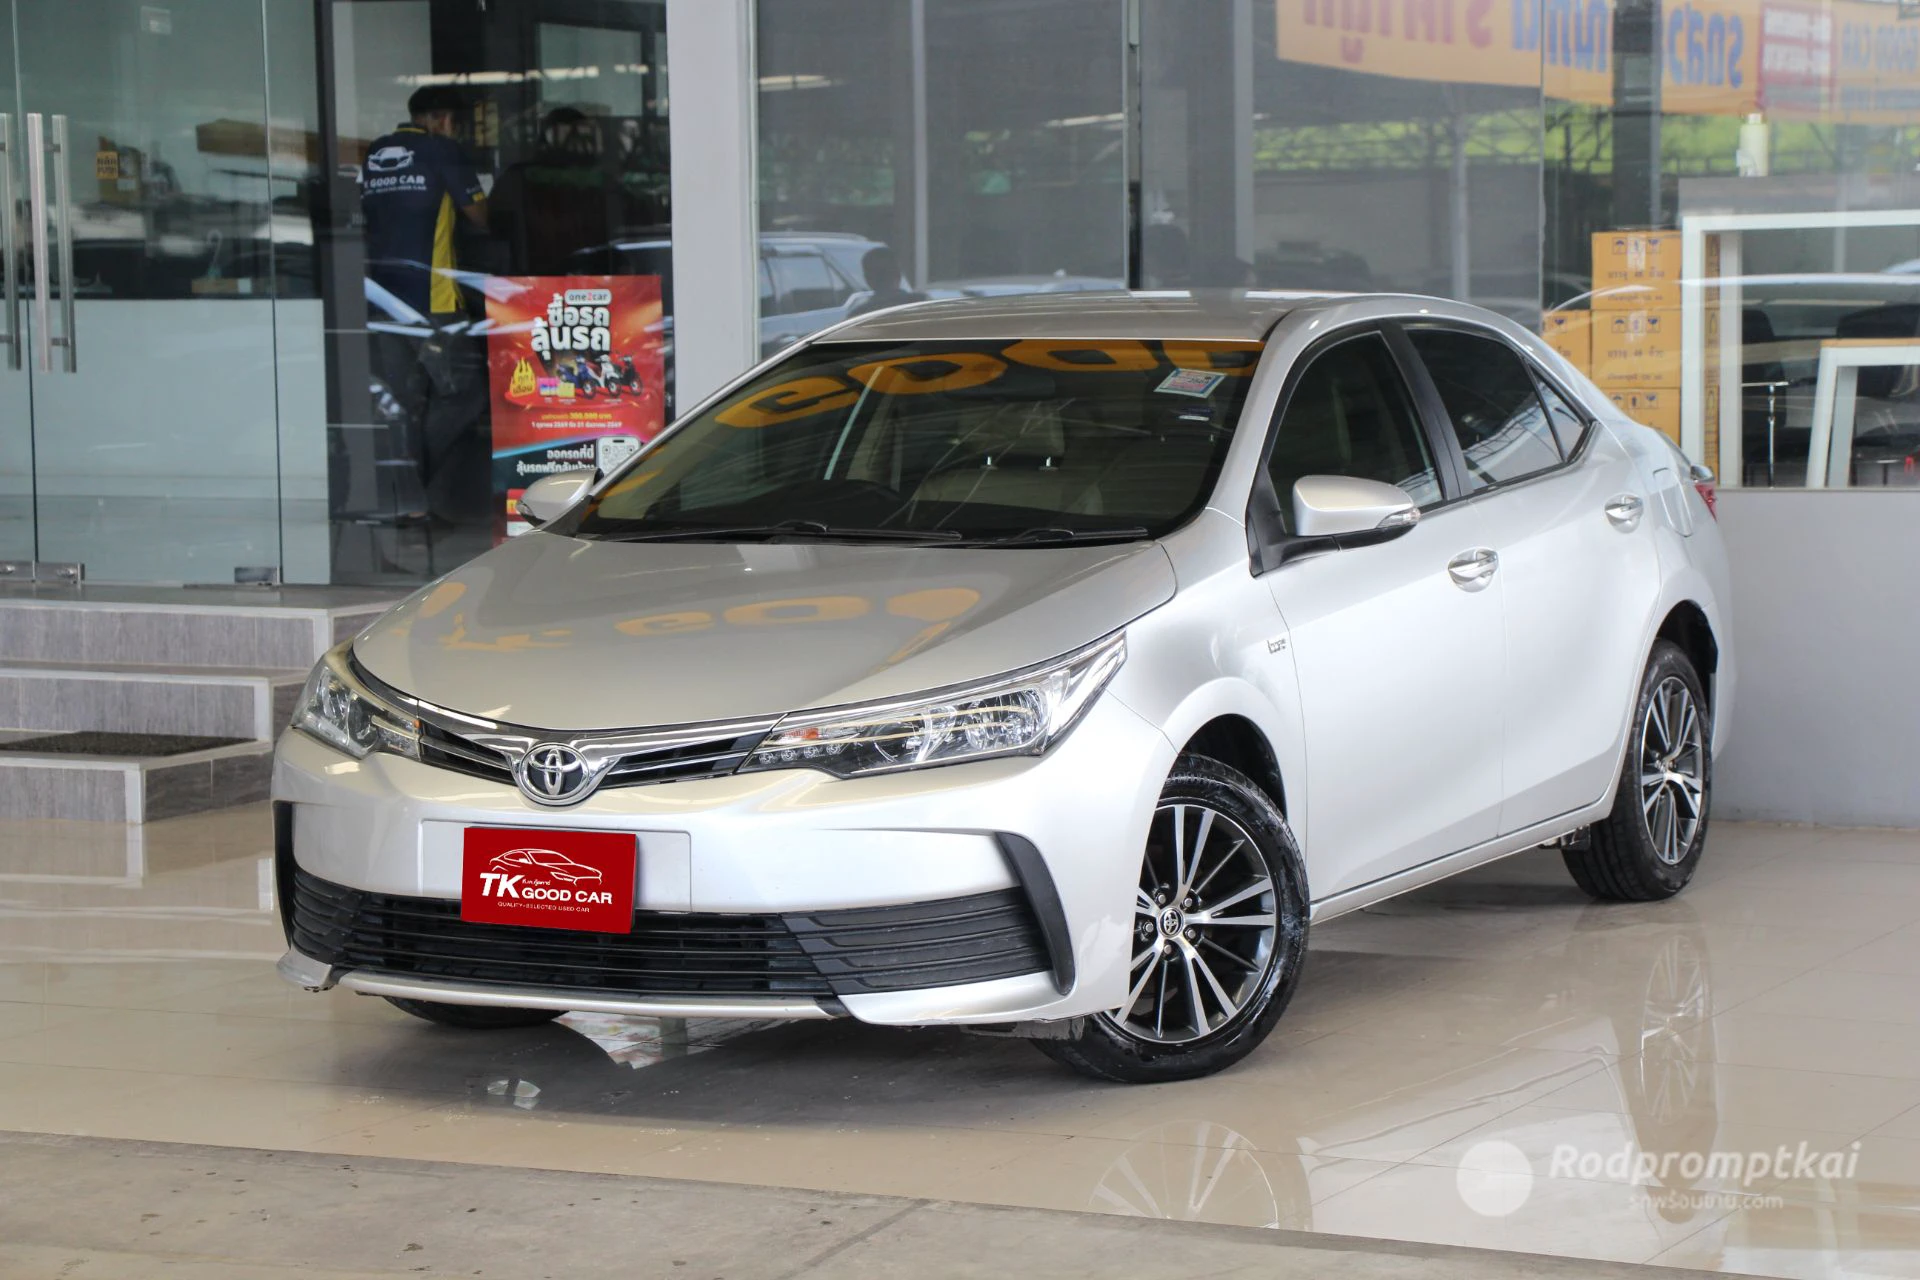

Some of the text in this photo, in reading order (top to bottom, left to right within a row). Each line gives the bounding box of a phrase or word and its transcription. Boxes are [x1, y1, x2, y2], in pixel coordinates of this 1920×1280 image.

[399, 174, 426, 185] CAR
[568, 290, 608, 301] one2car
[547, 292, 610, 327] ซื้อรถ
[531, 316, 611, 361] ลุ้นรถ
[547, 444, 594, 460] ออกรถที่นี่
[479, 872, 613, 905] TK GOOD CAR
